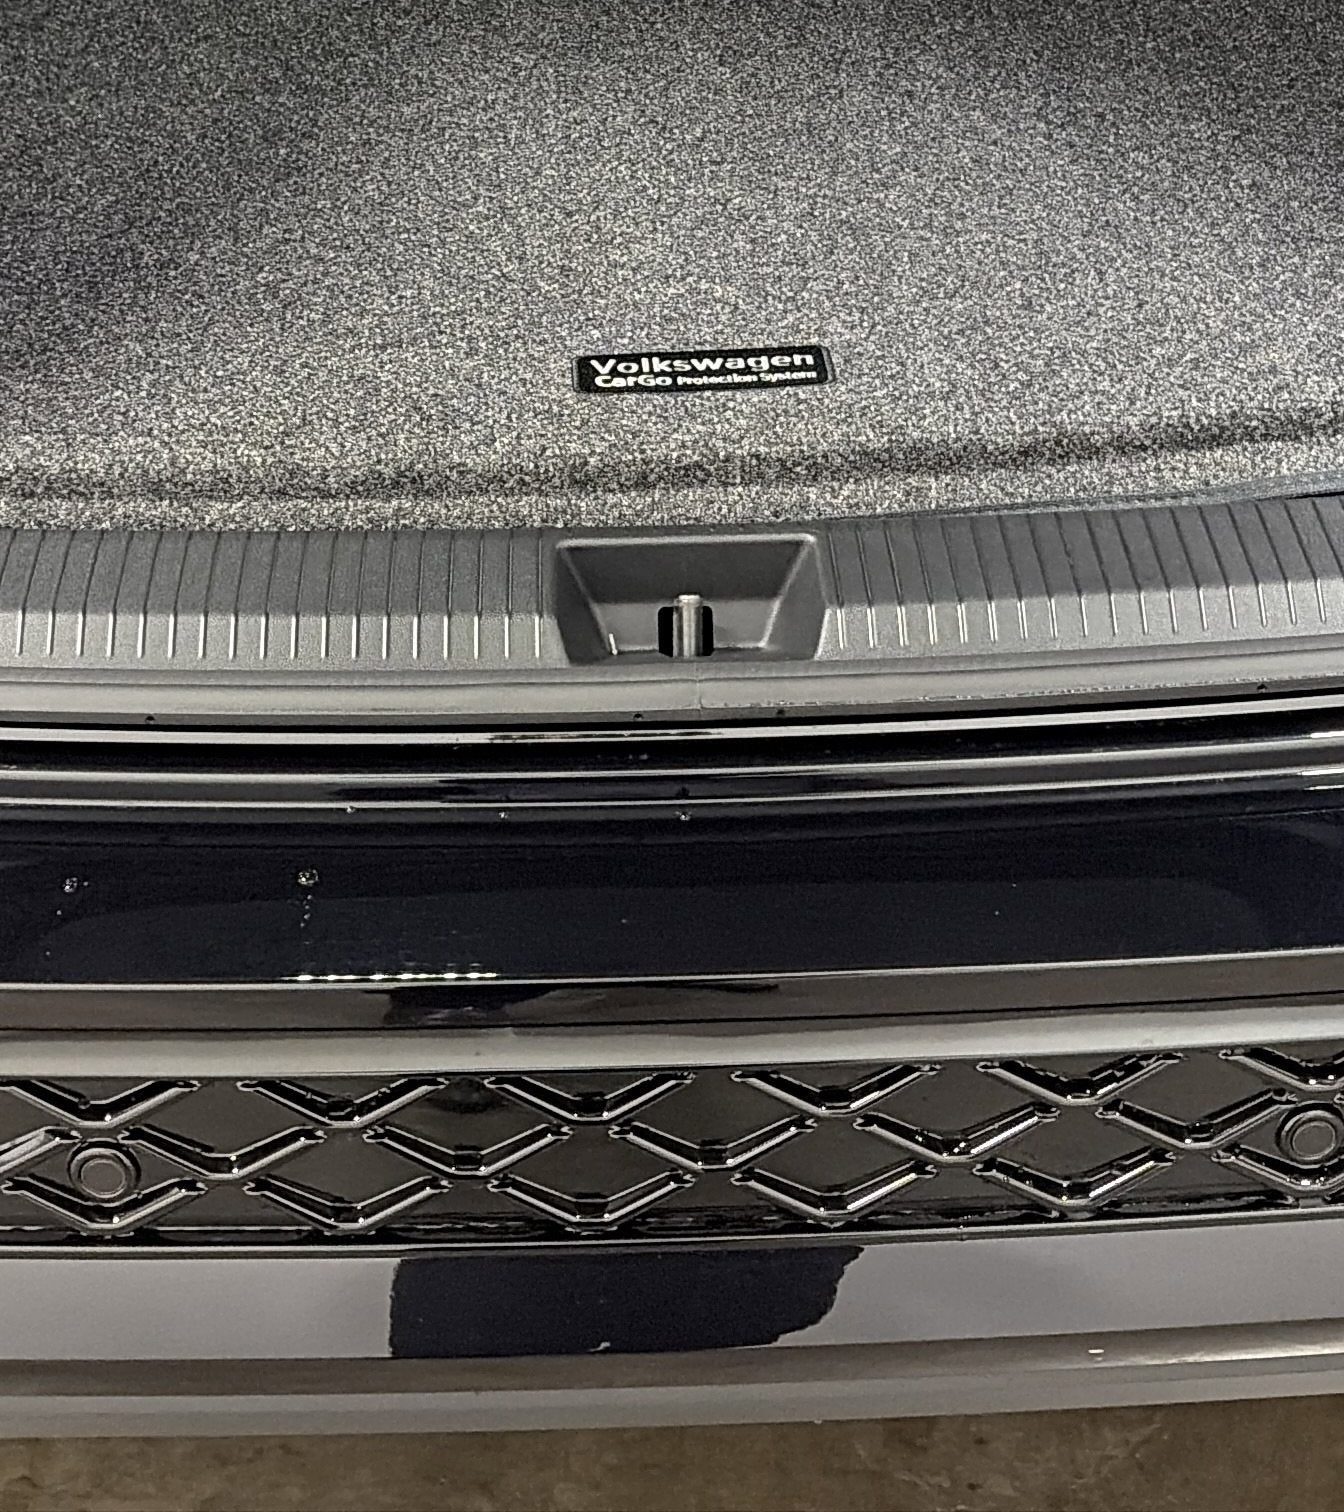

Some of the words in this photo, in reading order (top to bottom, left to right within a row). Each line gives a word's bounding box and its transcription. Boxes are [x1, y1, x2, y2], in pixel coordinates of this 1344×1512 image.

[590, 353, 814, 375] Volkswagen
[677, 373, 758, 386] Protection
[759, 371, 817, 383] System
